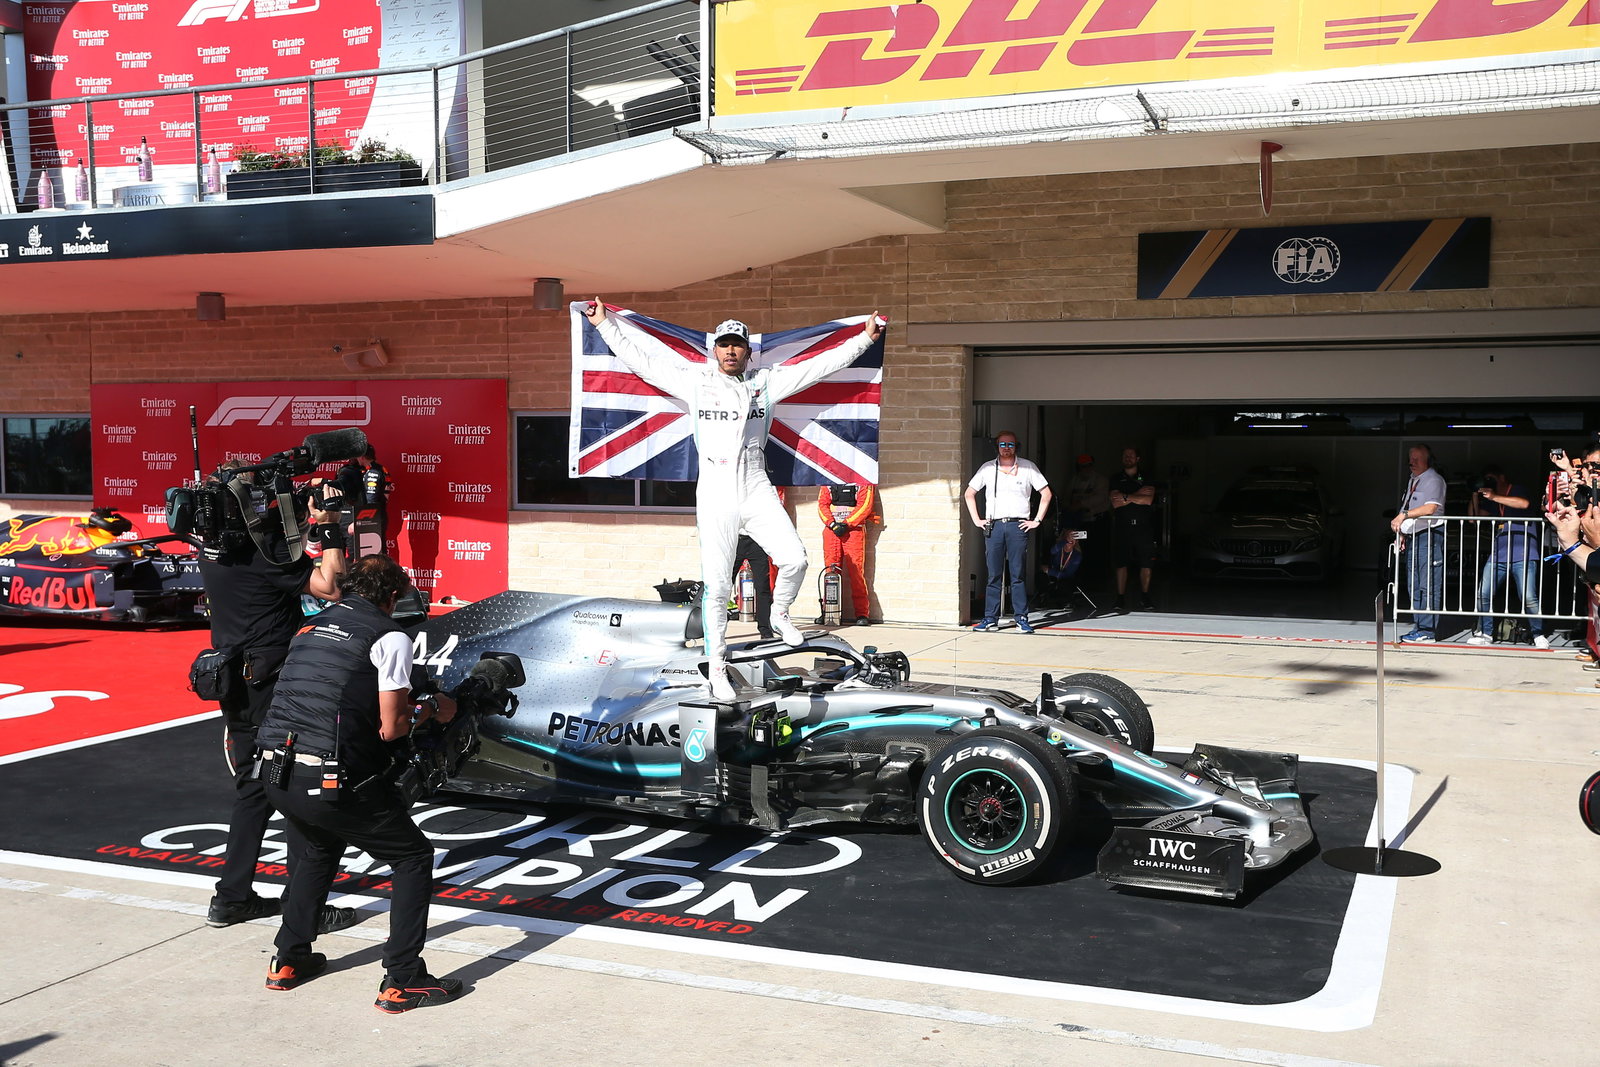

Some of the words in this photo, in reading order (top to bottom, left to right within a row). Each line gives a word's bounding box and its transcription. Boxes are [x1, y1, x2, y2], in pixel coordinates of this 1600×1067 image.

[26, 6, 66, 15] Emirates
[112, 3, 149, 13] Emirates
[73, 29, 109, 39] Emirates
[343, 26, 372, 38] Emirates
[272, 38, 305, 49] Emirates
[798, 0, 1196, 90] DHL
[116, 51, 152, 61] Emirates
[197, 46, 230, 56] Emirates
[310, 57, 340, 69] Emirates
[236, 67, 269, 77] Emirates
[75, 77, 112, 86] Emirates
[159, 73, 194, 83] Emirates
[344, 77, 374, 88] Emirates
[274, 87, 307, 98] Emirates
[119, 99, 154, 108] Emirates
[200, 95, 232, 104] Emirates
[237, 115, 270, 125] Emirates
[160, 121, 196, 131] Emirate
[275, 136, 308, 146] Emirates
[19, 245, 53, 256] Emirates
[63, 242, 109, 255] Heineken
[141, 398, 176, 408] Emirates
[401, 395, 441, 406] Emirates
[407, 407, 416, 415] FLY
[417, 407, 436, 415] BETTER
[103, 425, 136, 434] Emirates
[448, 424, 491, 434] Emirates
[108, 435, 116, 443] FLY
[116, 435, 131, 443] BETTER
[454, 436, 463, 444] FLY
[465, 436, 484, 444] BETTER
[143, 451, 177, 461] Emirates
[401, 453, 441, 463] Emirates
[156, 462, 172, 470] BETTER
[407, 464, 416, 472] FLY
[417, 464, 436, 473] BETTER
[104, 477, 137, 487] Emirates
[117, 488, 132, 496] BETTER
[448, 482, 491, 493] Emirates
[455, 494, 464, 502] FLY
[465, 494, 485, 503] BETTER
[143, 504, 166, 514] Emira
[147, 515, 155, 523] FLY
[401, 510, 441, 521] Emirates
[417, 522, 435, 530] BETTER
[448, 540, 491, 551] Emirates
[454, 552, 463, 560] FLY
[465, 552, 485, 560] BETTER
[418, 579, 436, 587] BETTER
[413, 631, 458, 676] 44
[548, 712, 681, 747] PETRONAS
[941, 746, 1011, 773] ZERO
[1149, 837, 1196, 860] IWC
[979, 848, 1035, 878] PIRELLI
[1133, 859, 1210, 874] SCHAFFHAUSEN
[610, 909, 754, 934] REMOVED
